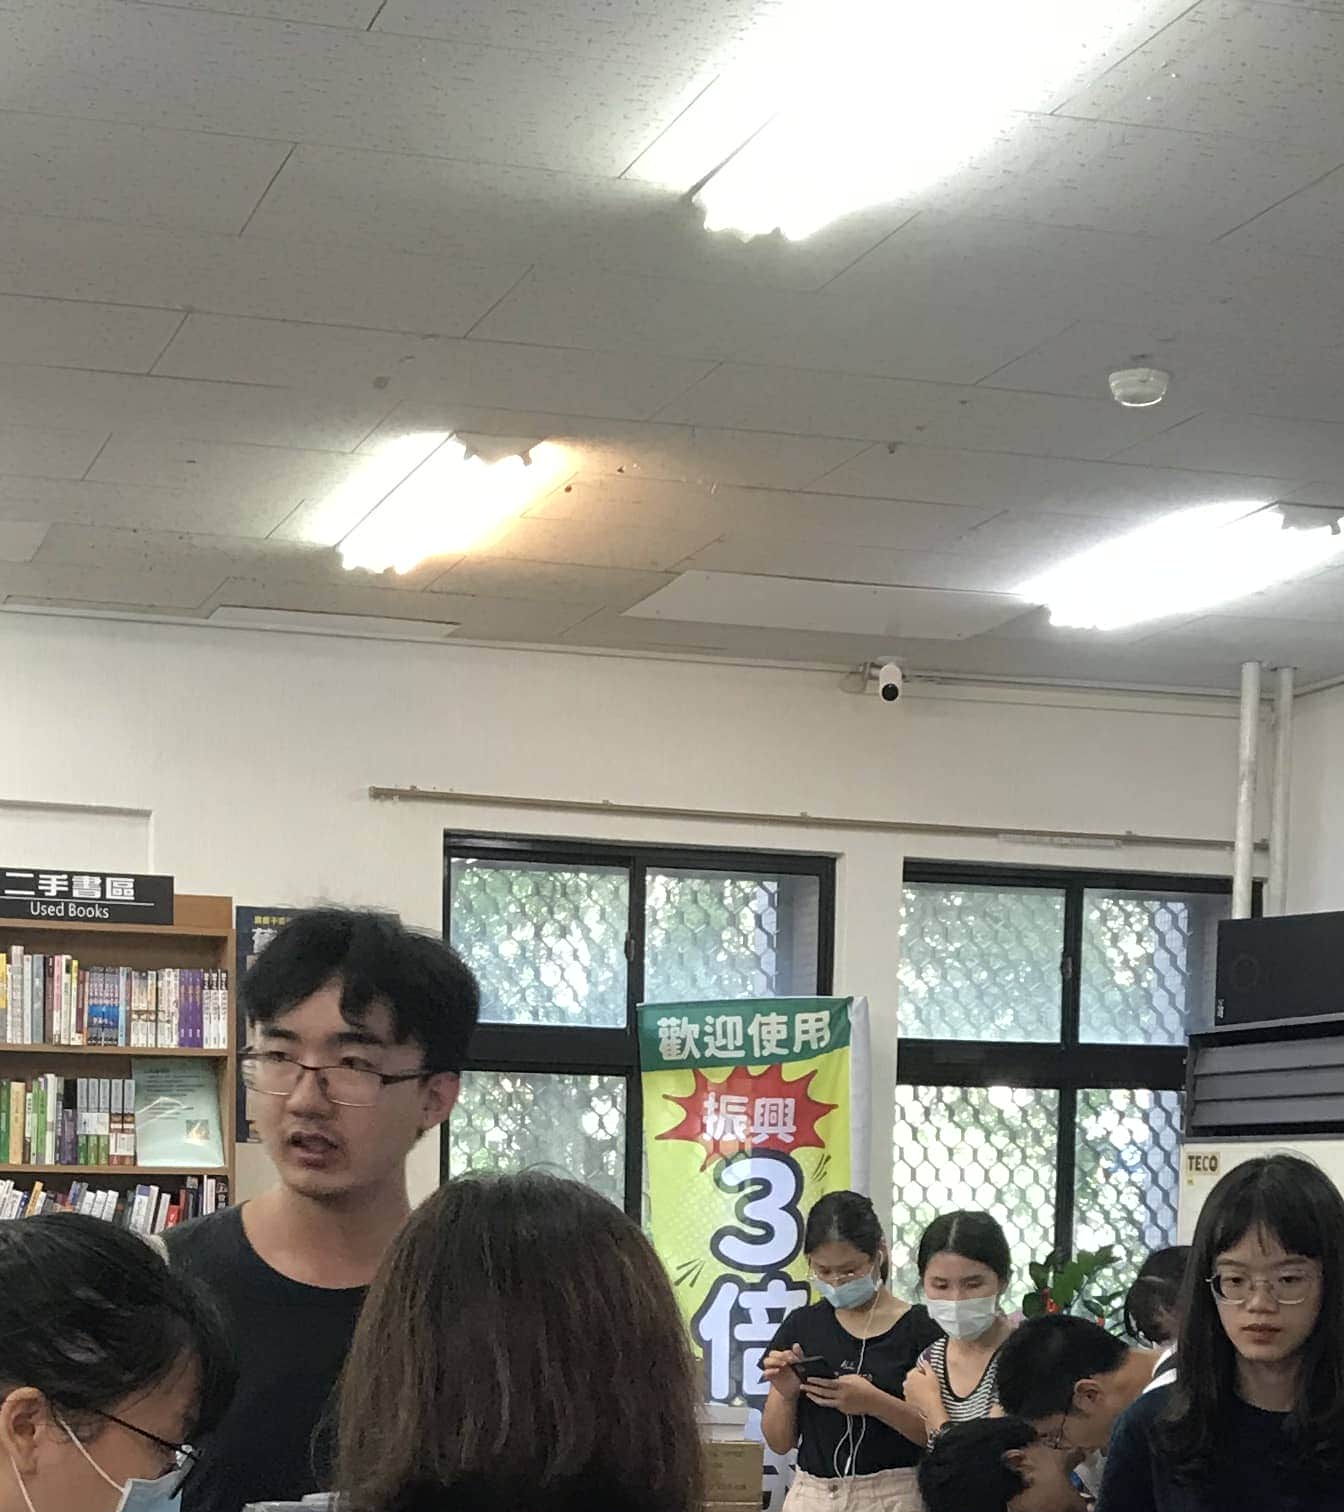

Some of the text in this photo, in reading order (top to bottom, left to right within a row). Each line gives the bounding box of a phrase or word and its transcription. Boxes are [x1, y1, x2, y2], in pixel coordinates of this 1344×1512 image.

[4, 871, 136, 900] 二手書區
[30, 901, 110, 919] Used Books
[658, 1010, 831, 1062] 歡迎使用
[702, 1092, 798, 1144] 振興
[1187, 1155, 1218, 1172] TECO
